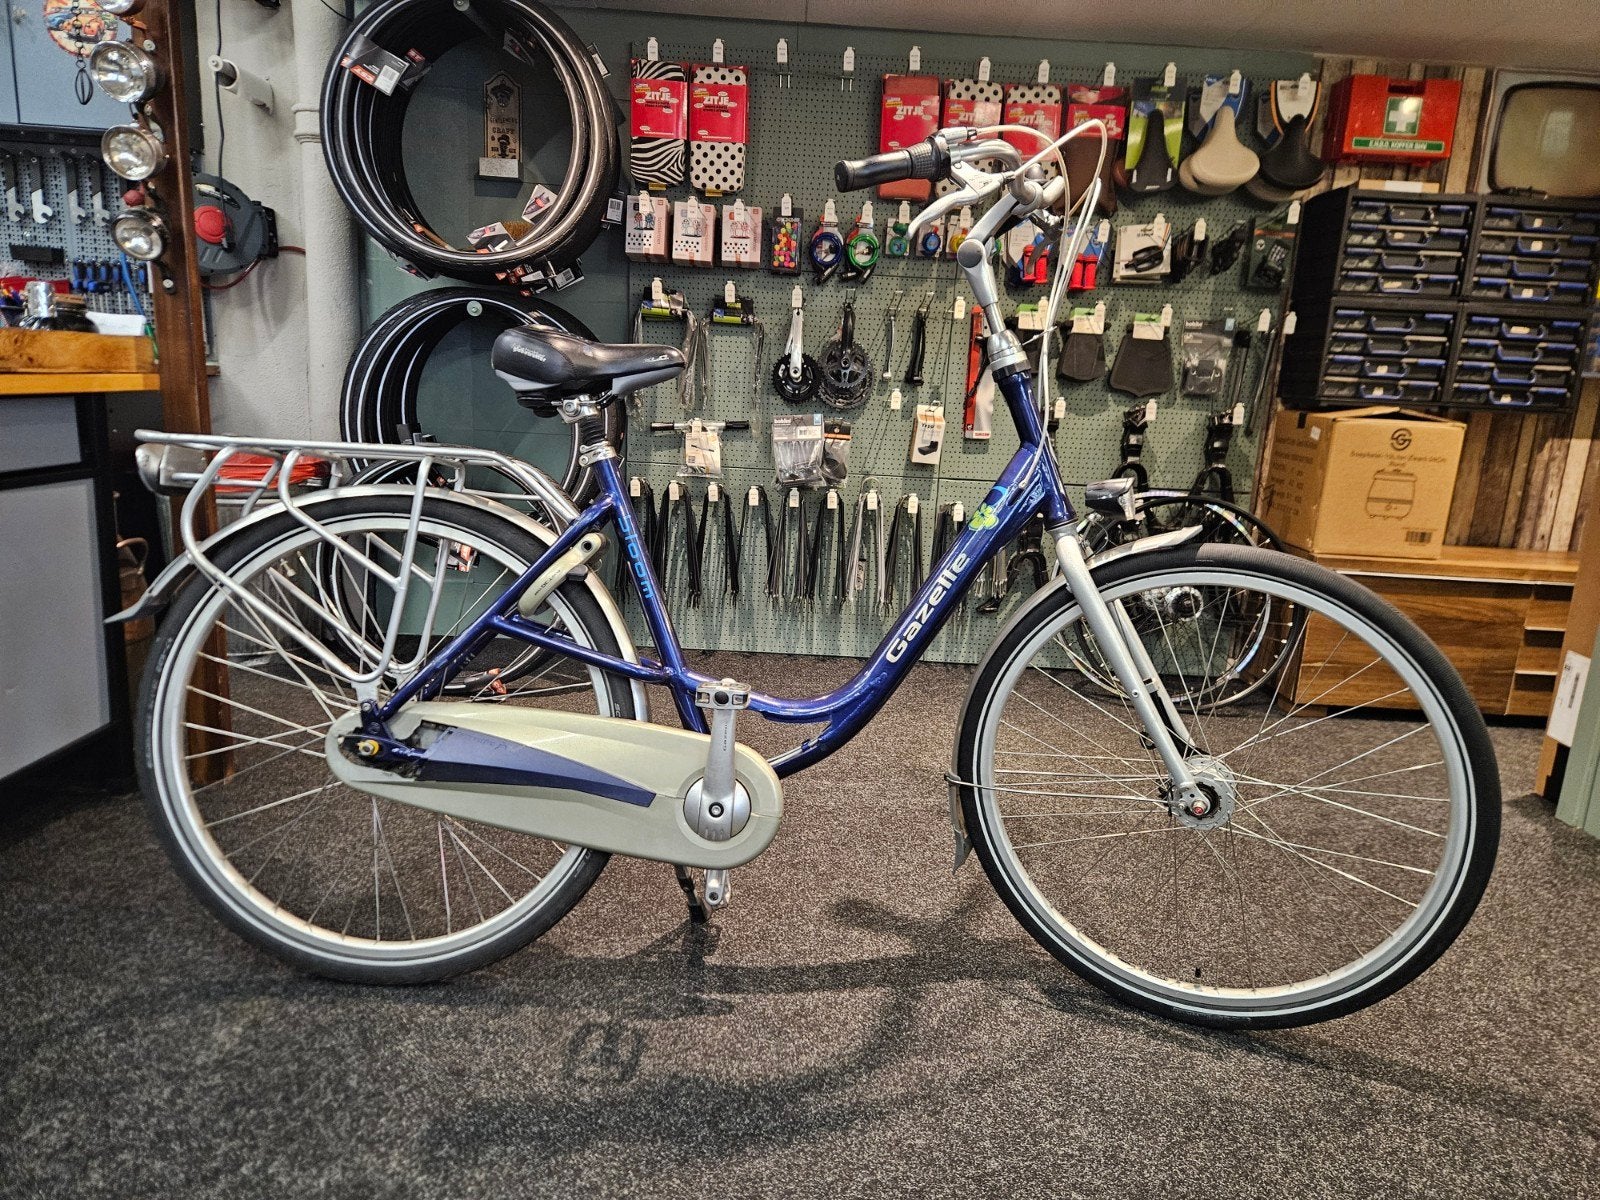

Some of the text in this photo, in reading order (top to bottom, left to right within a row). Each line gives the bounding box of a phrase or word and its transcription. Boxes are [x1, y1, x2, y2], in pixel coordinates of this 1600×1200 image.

[644, 91, 671, 101] ZITJE
[703, 95, 730, 106] ZITJE
[896, 105, 924, 116] ZITJE
[618, 514, 654, 599] bloom
[885, 552, 971, 664] Gazelle
